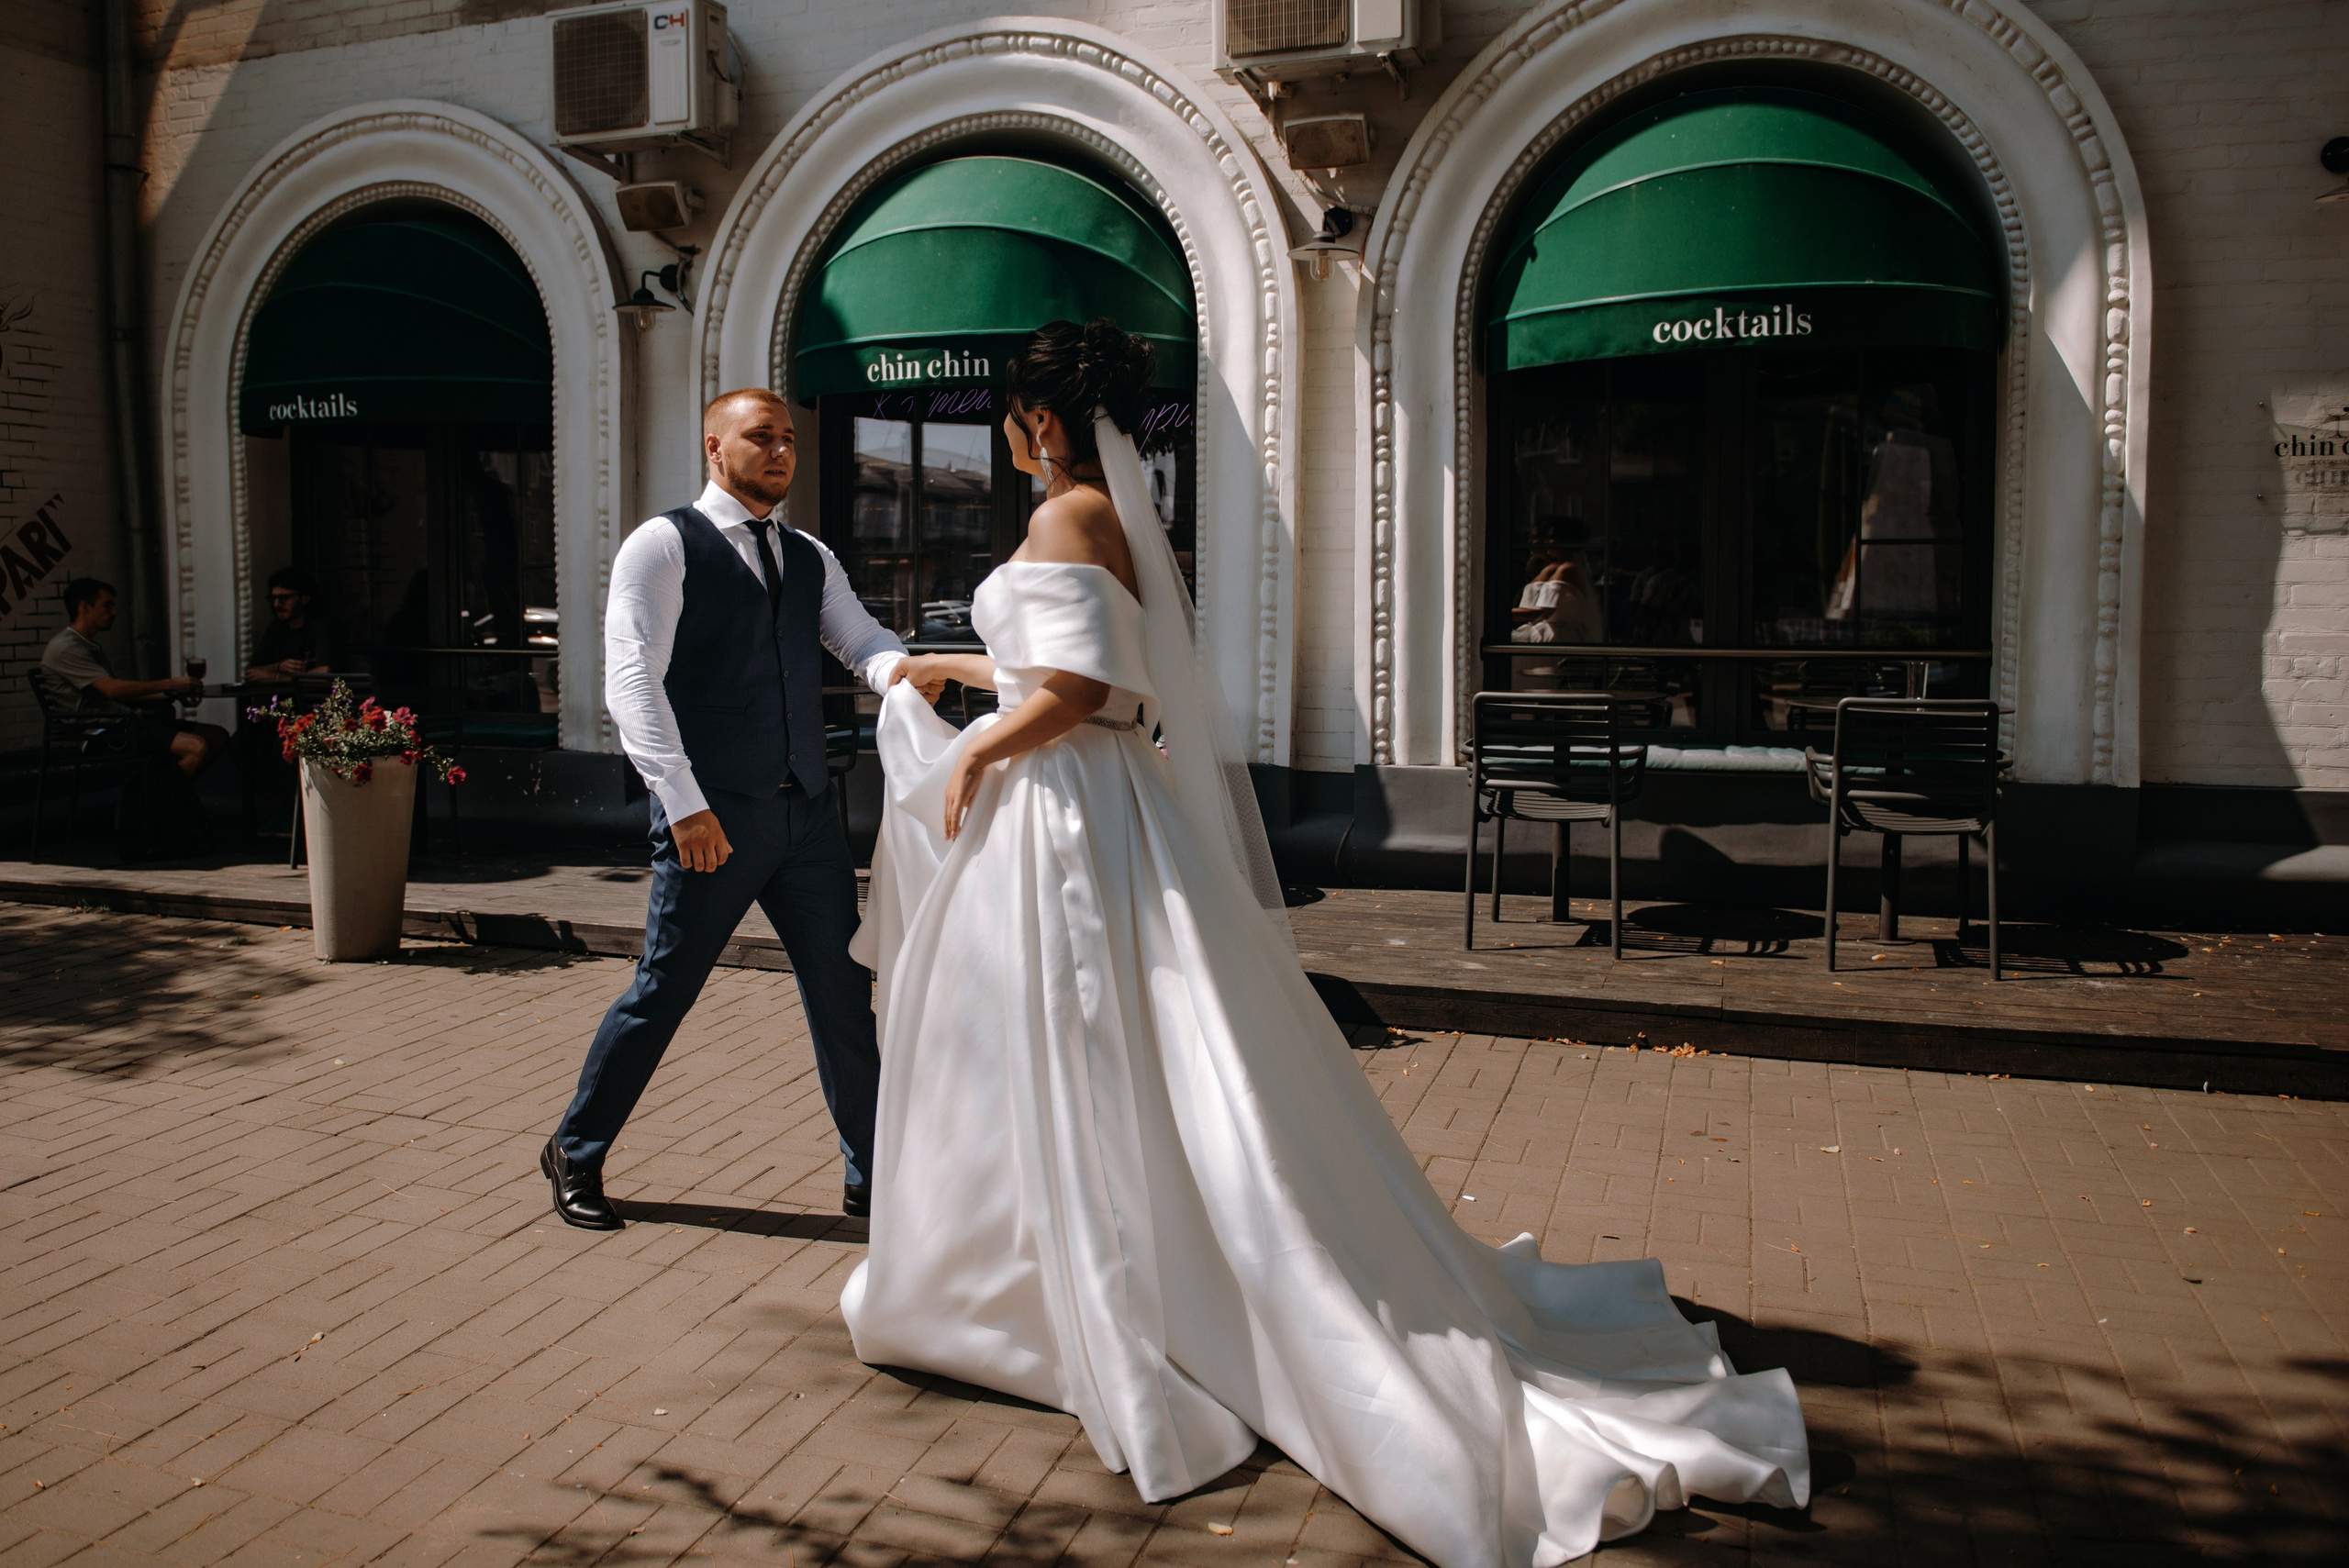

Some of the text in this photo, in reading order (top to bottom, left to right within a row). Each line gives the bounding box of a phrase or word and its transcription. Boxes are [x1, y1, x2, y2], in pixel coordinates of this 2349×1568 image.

[654, 12, 685, 30] CH
[1653, 304, 1812, 343] cocktails
[867, 350, 991, 382] chin chin
[269, 393, 358, 420] cocktails
[2275, 434, 2334, 457] chin
